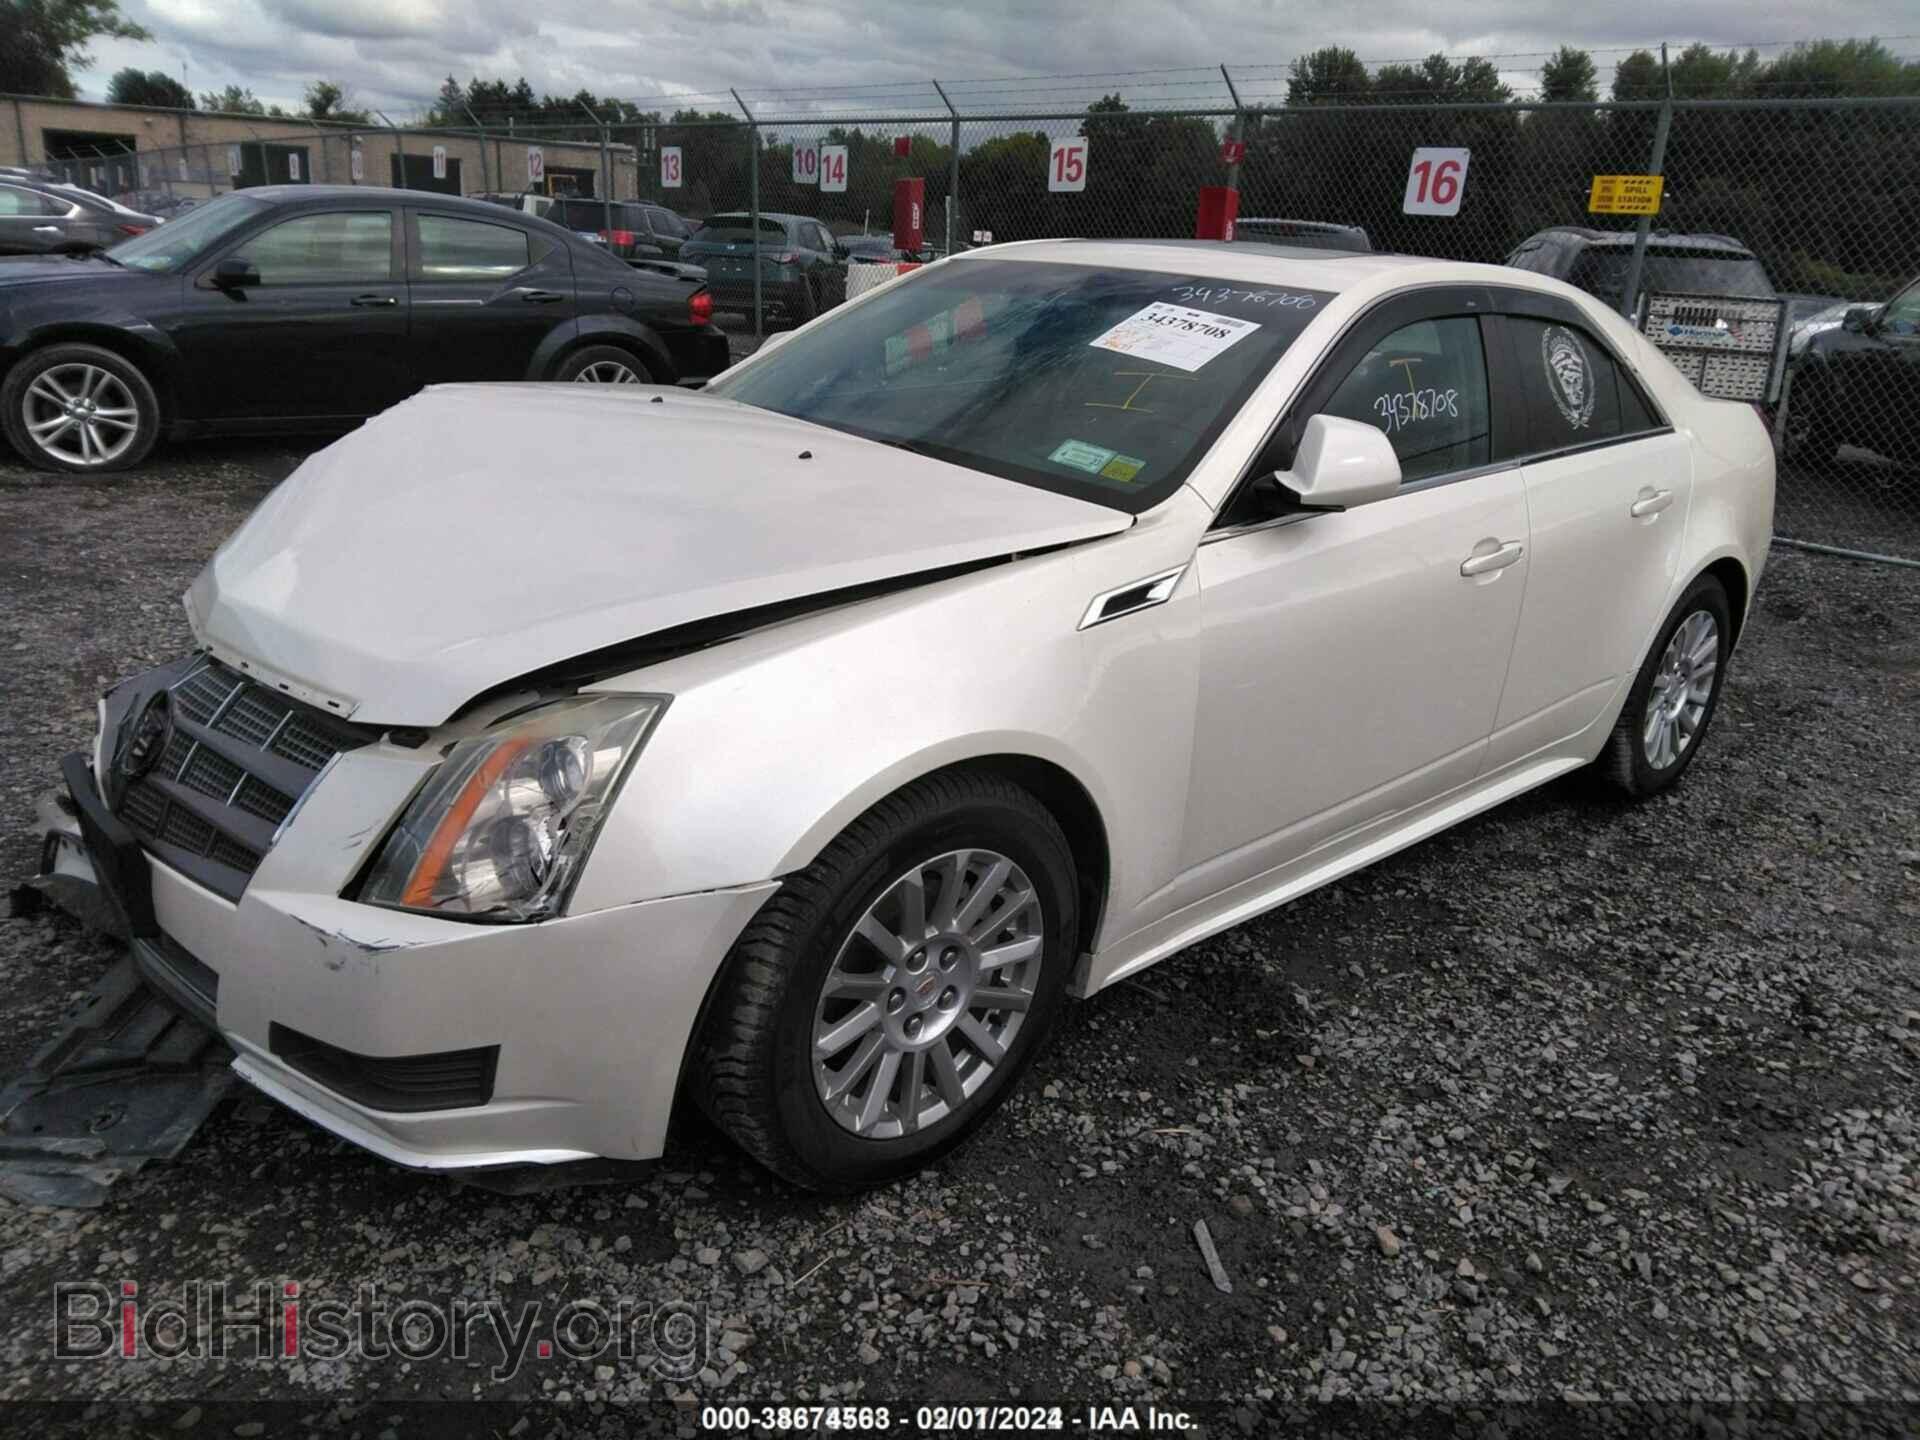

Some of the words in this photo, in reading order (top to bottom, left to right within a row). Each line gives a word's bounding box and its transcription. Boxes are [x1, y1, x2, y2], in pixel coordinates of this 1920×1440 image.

[434, 151, 445, 174] 11
[529, 153, 542, 176] 12
[663, 154, 679, 180] 13
[795, 148, 816, 175] 10
[824, 154, 845, 184] 14
[1053, 146, 1083, 182] 15
[1414, 160, 1461, 204] 16
[1624, 186, 1648, 194] SPILL
[1618, 195, 1652, 204] STATION
[1140, 312, 1233, 340] 34378708
[1374, 388, 1459, 434] 34378708
